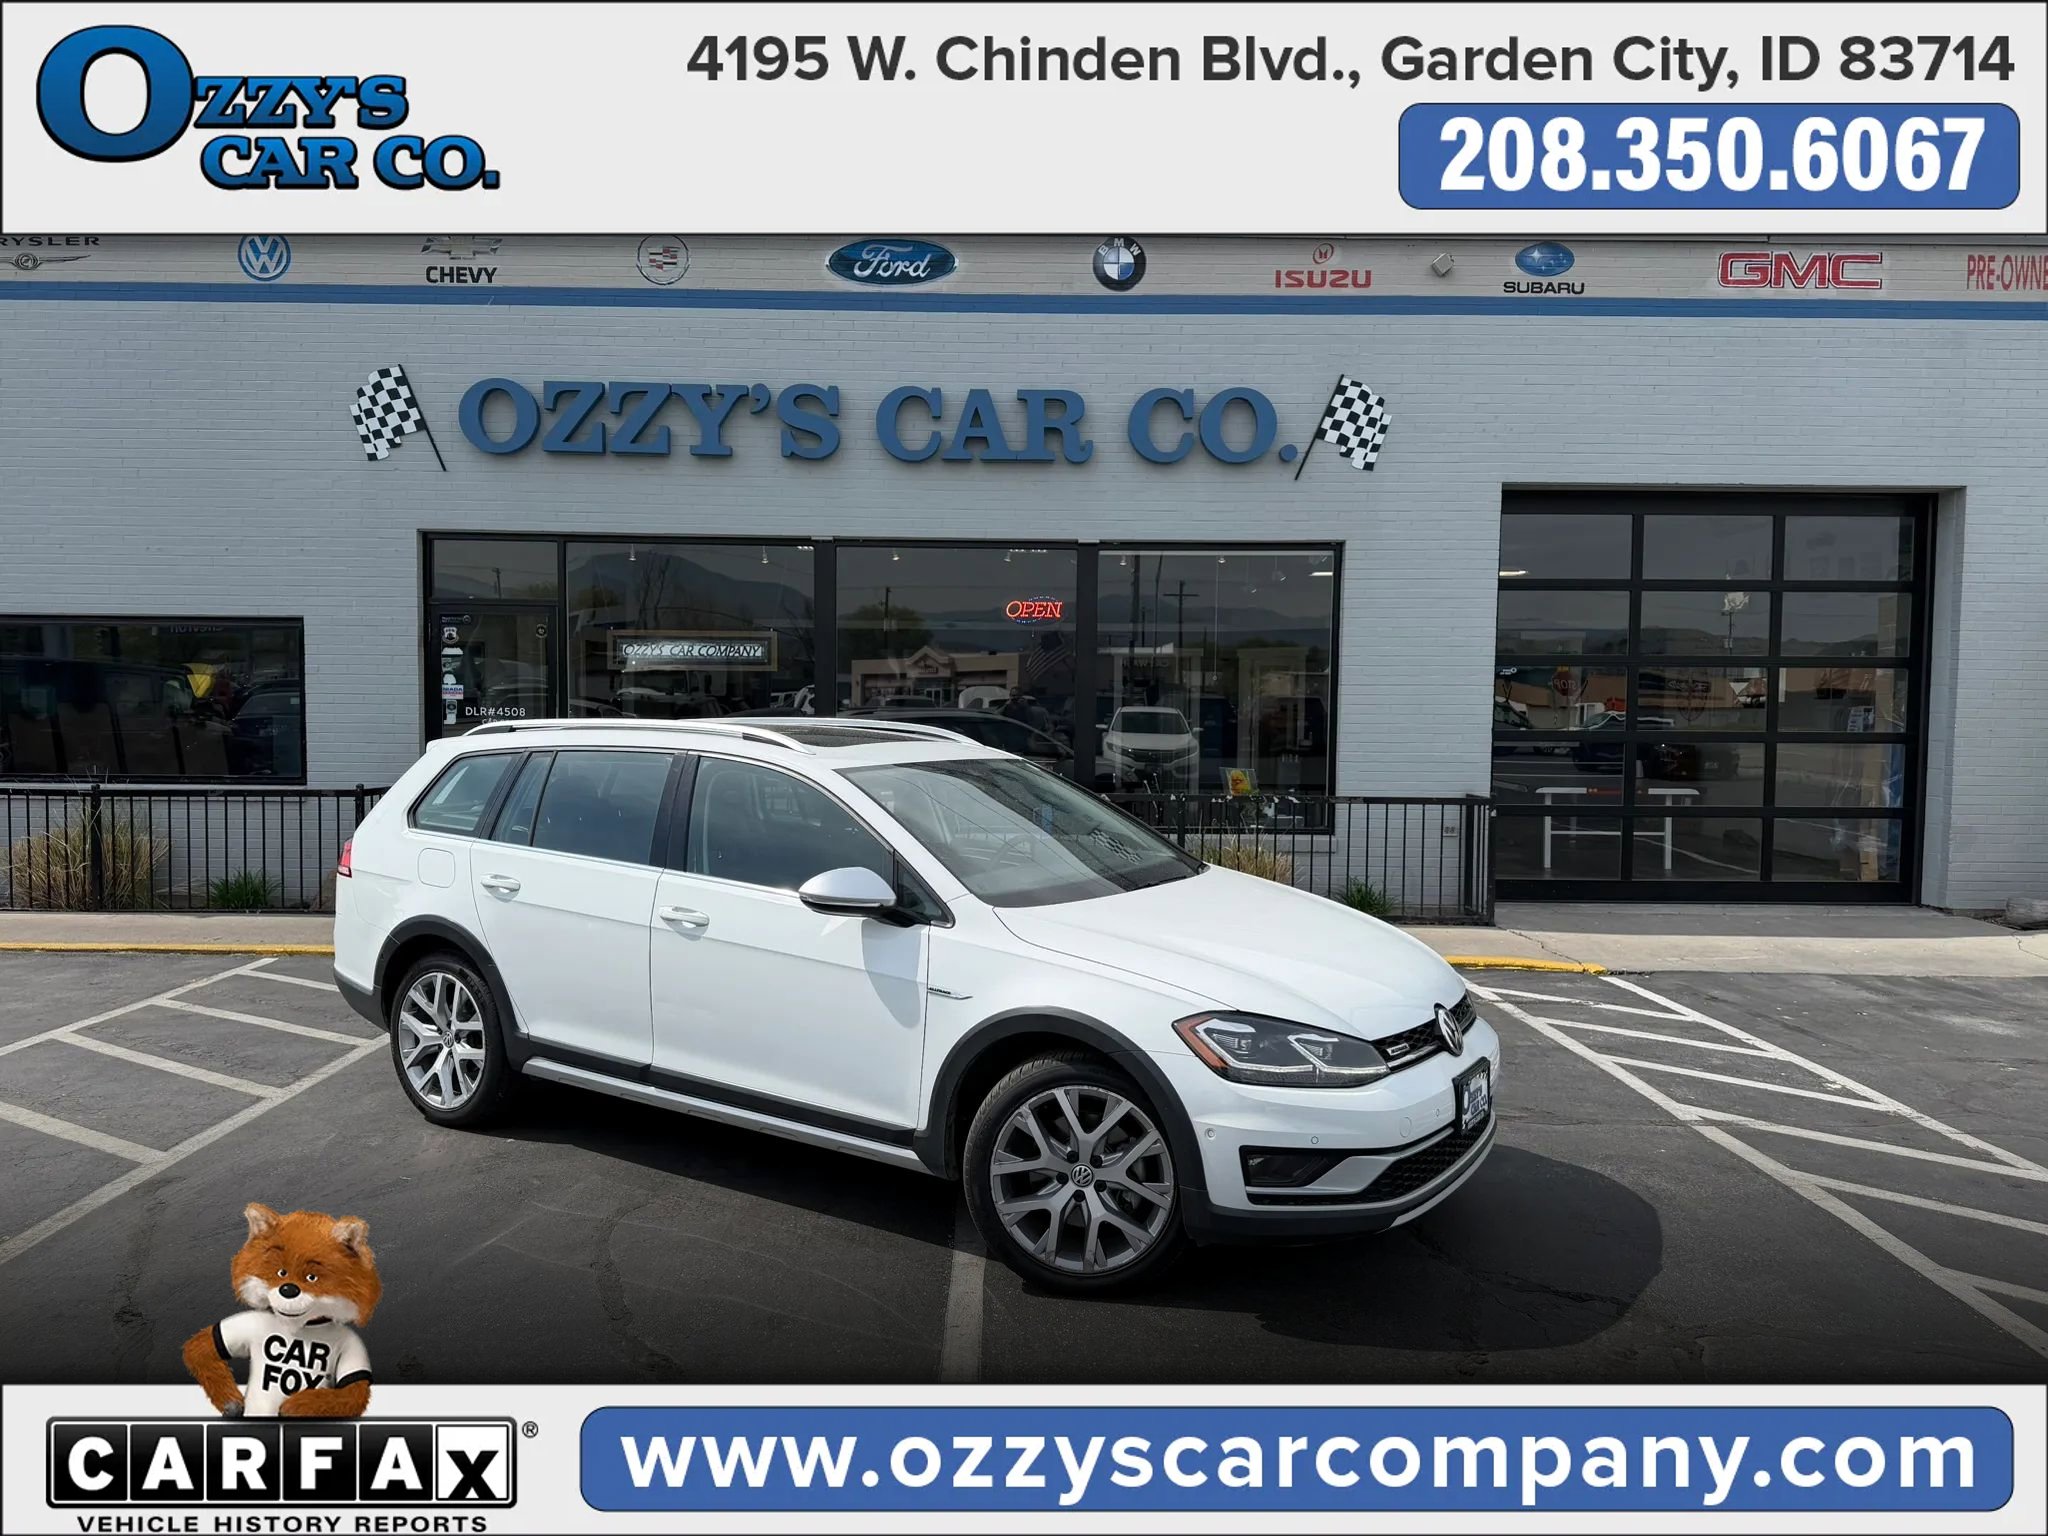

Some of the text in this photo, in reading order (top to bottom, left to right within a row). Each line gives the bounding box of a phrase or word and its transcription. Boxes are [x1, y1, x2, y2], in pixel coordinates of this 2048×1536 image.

[1098, 237, 1141, 256] BMW
[853, 244, 931, 278] Ford
[1718, 251, 1882, 288] GMC
[426, 266, 498, 283] CHEVY
[1275, 270, 1371, 288] ISUZU
[1503, 281, 1585, 295] SUBARU
[459, 378, 1297, 463] OZZY'S CAR CO.
[1006, 600, 1062, 618] OPEN
[669, 644, 694, 656] CAR
[697, 645, 762, 657] COMPANY
[465, 706, 526, 716] DLR#4508
